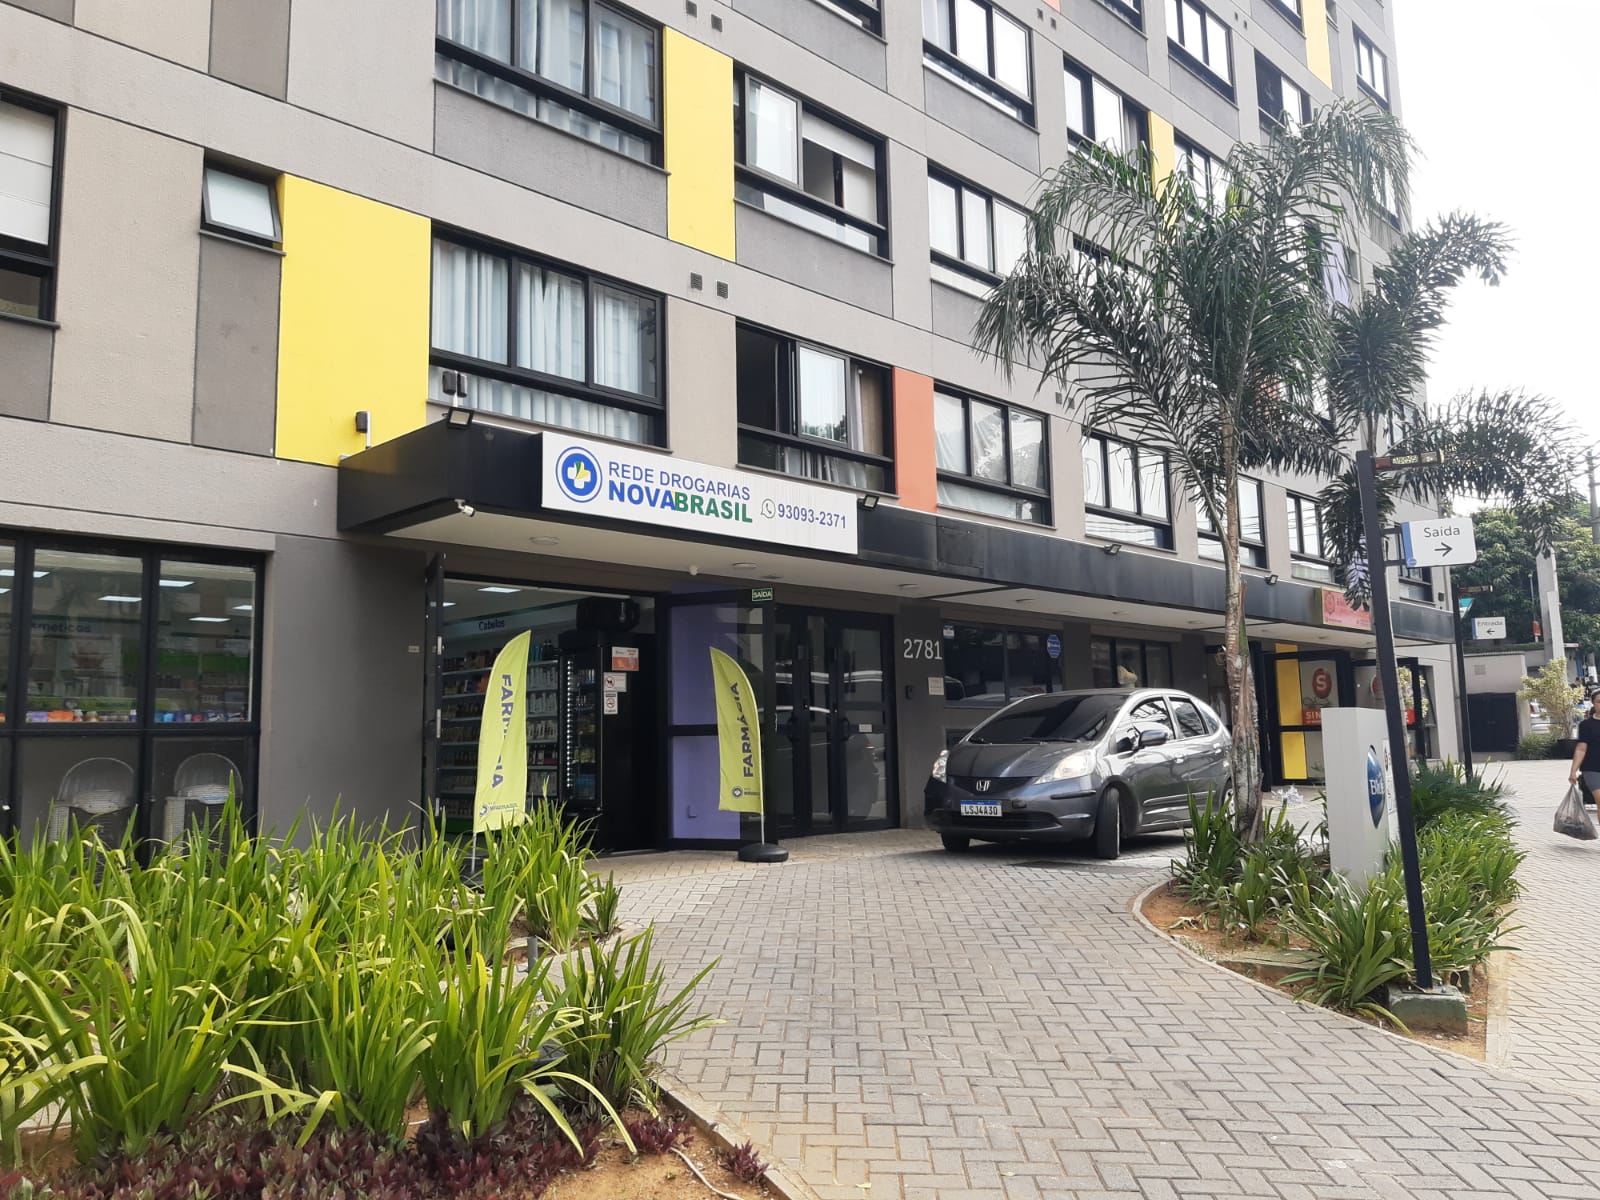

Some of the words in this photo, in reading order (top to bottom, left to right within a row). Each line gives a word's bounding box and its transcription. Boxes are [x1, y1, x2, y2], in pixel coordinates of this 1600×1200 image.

[608, 460, 654, 484] REDE
[659, 470, 751, 501] DROGARIAS
[777, 503, 846, 529] 93093-2371
[903, 638, 943, 660] 2781
